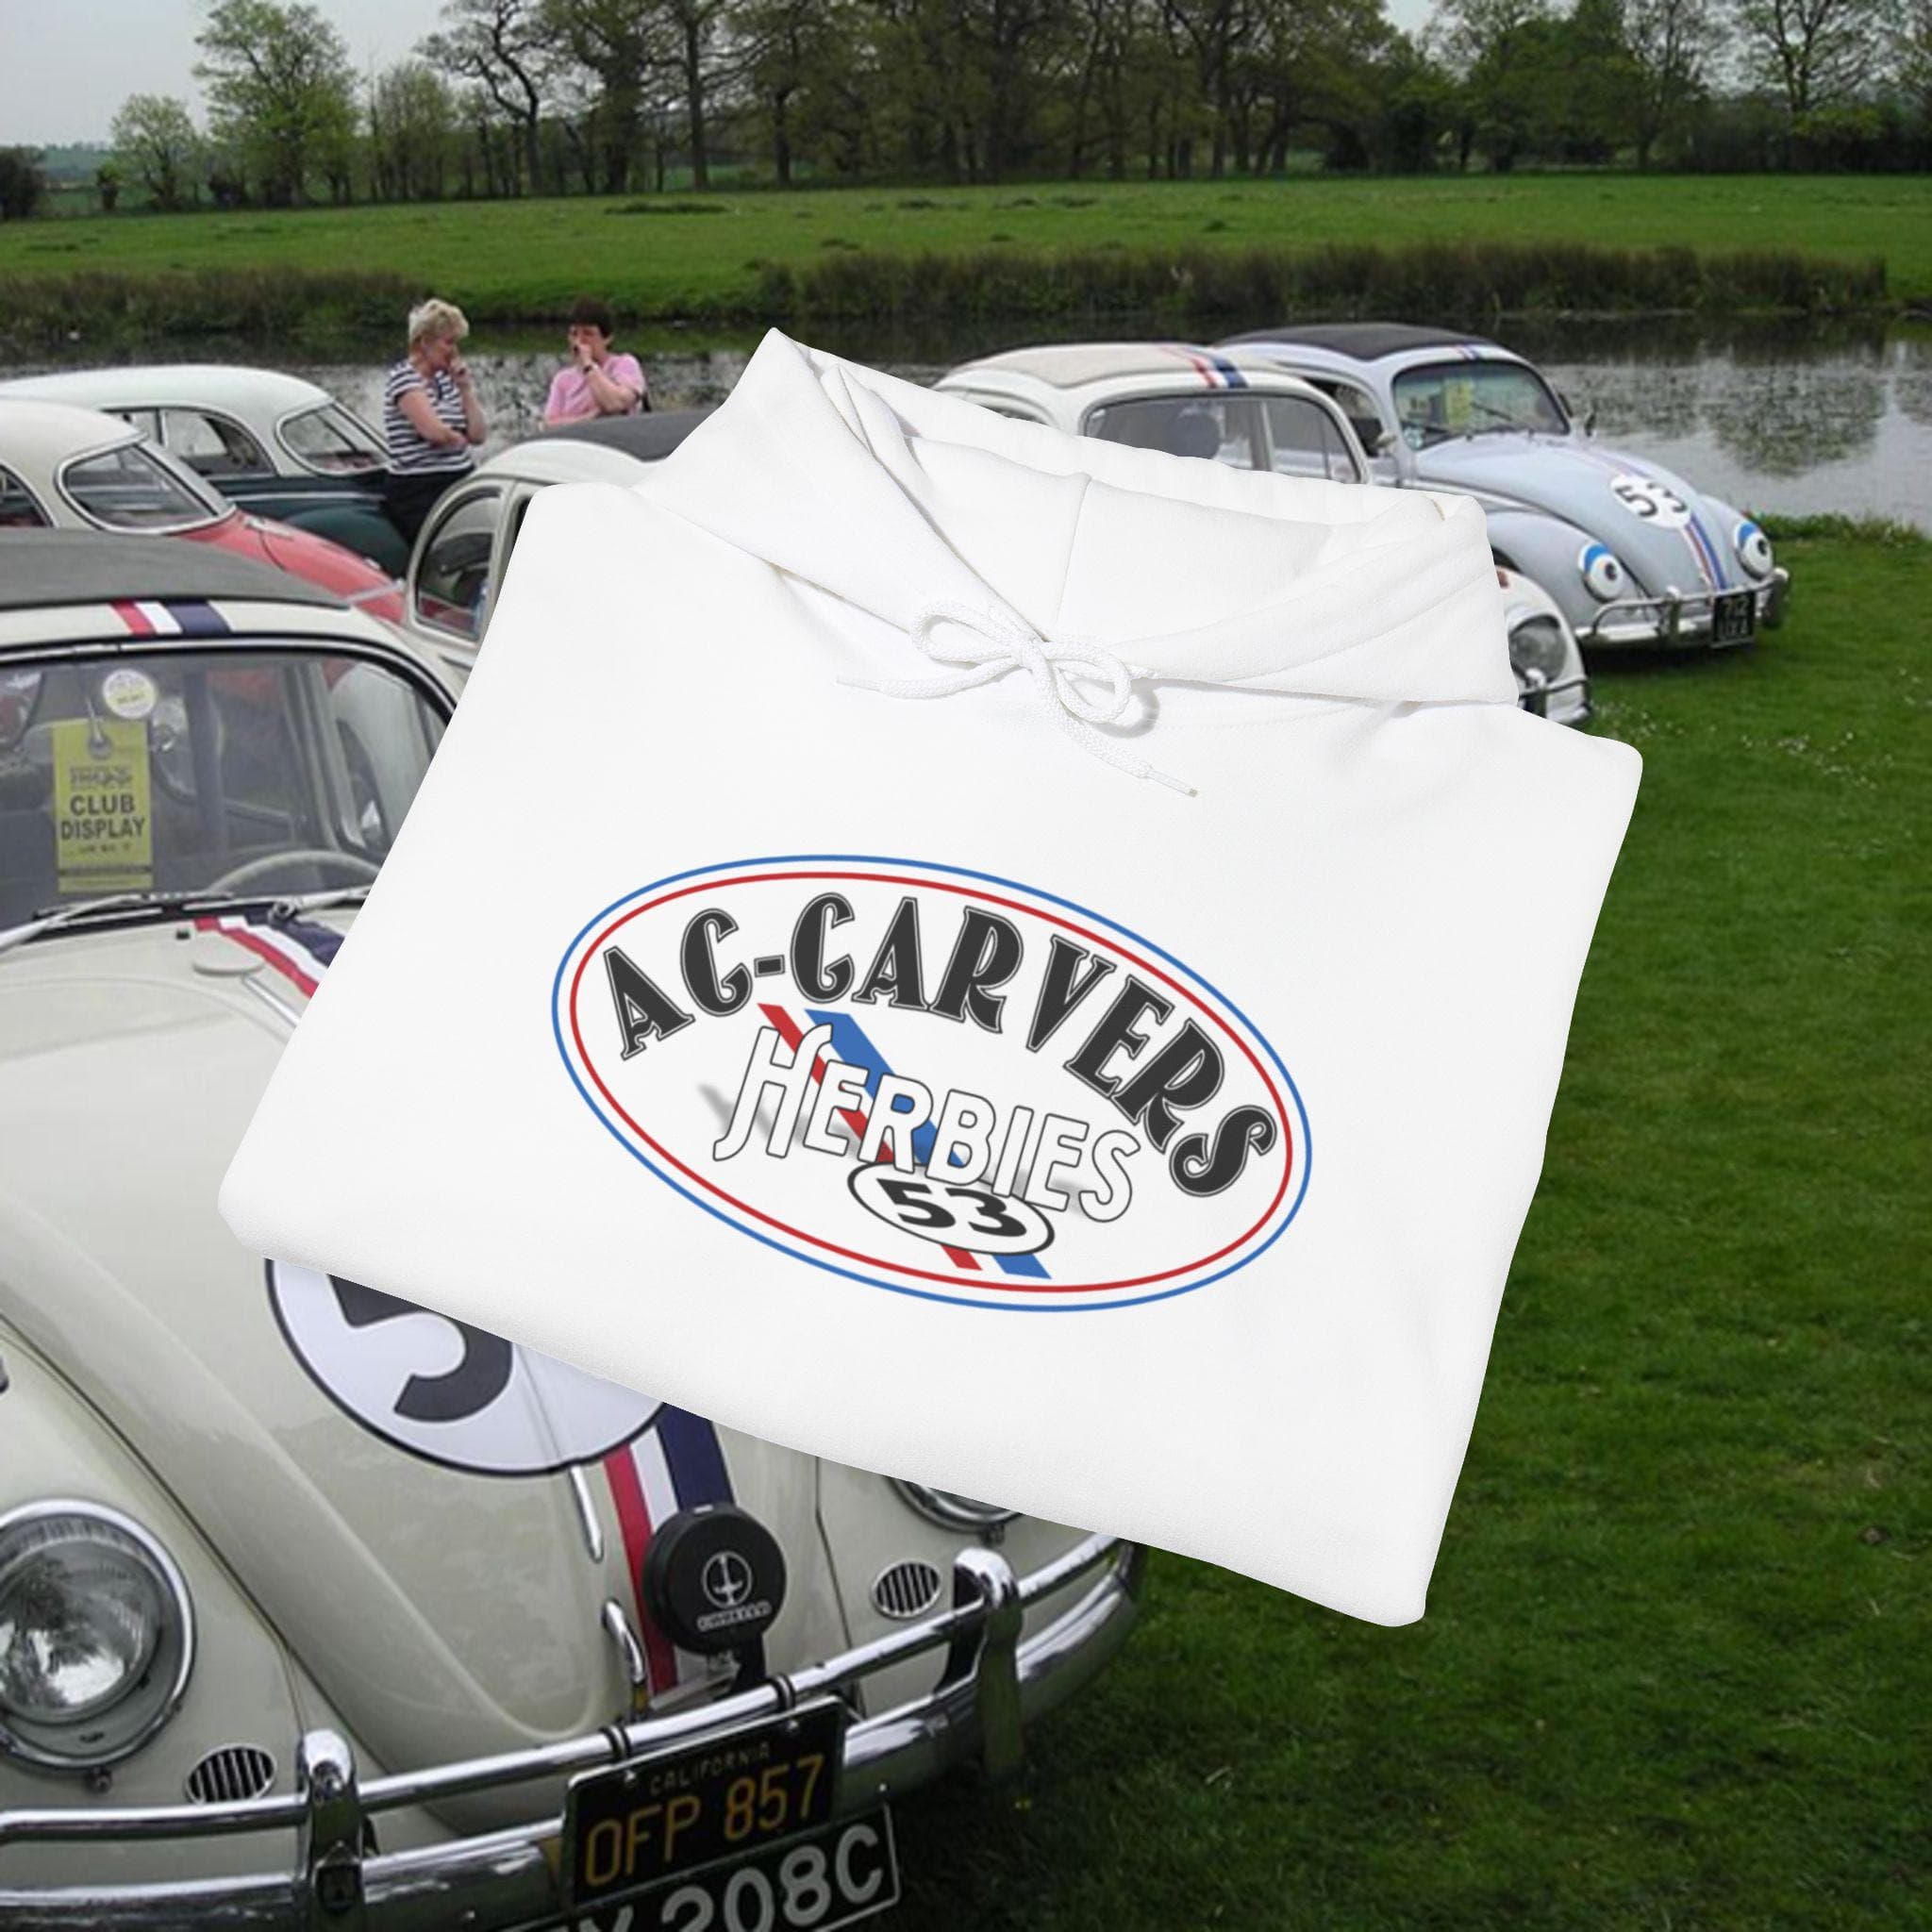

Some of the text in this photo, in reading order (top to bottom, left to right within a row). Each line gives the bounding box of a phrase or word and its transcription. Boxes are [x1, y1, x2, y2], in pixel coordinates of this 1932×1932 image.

[1614, 482, 1689, 518] 53
[60, 816, 145, 841] DISPLAY
[70, 794, 136, 816] CLUB
[602, 891, 1279, 1198] AC-CARVERS
[874, 1178, 1029, 1239] 53
[649, 1740, 771, 1797] CALIFORNIA
[584, 1754, 824, 1888] OFP 857
